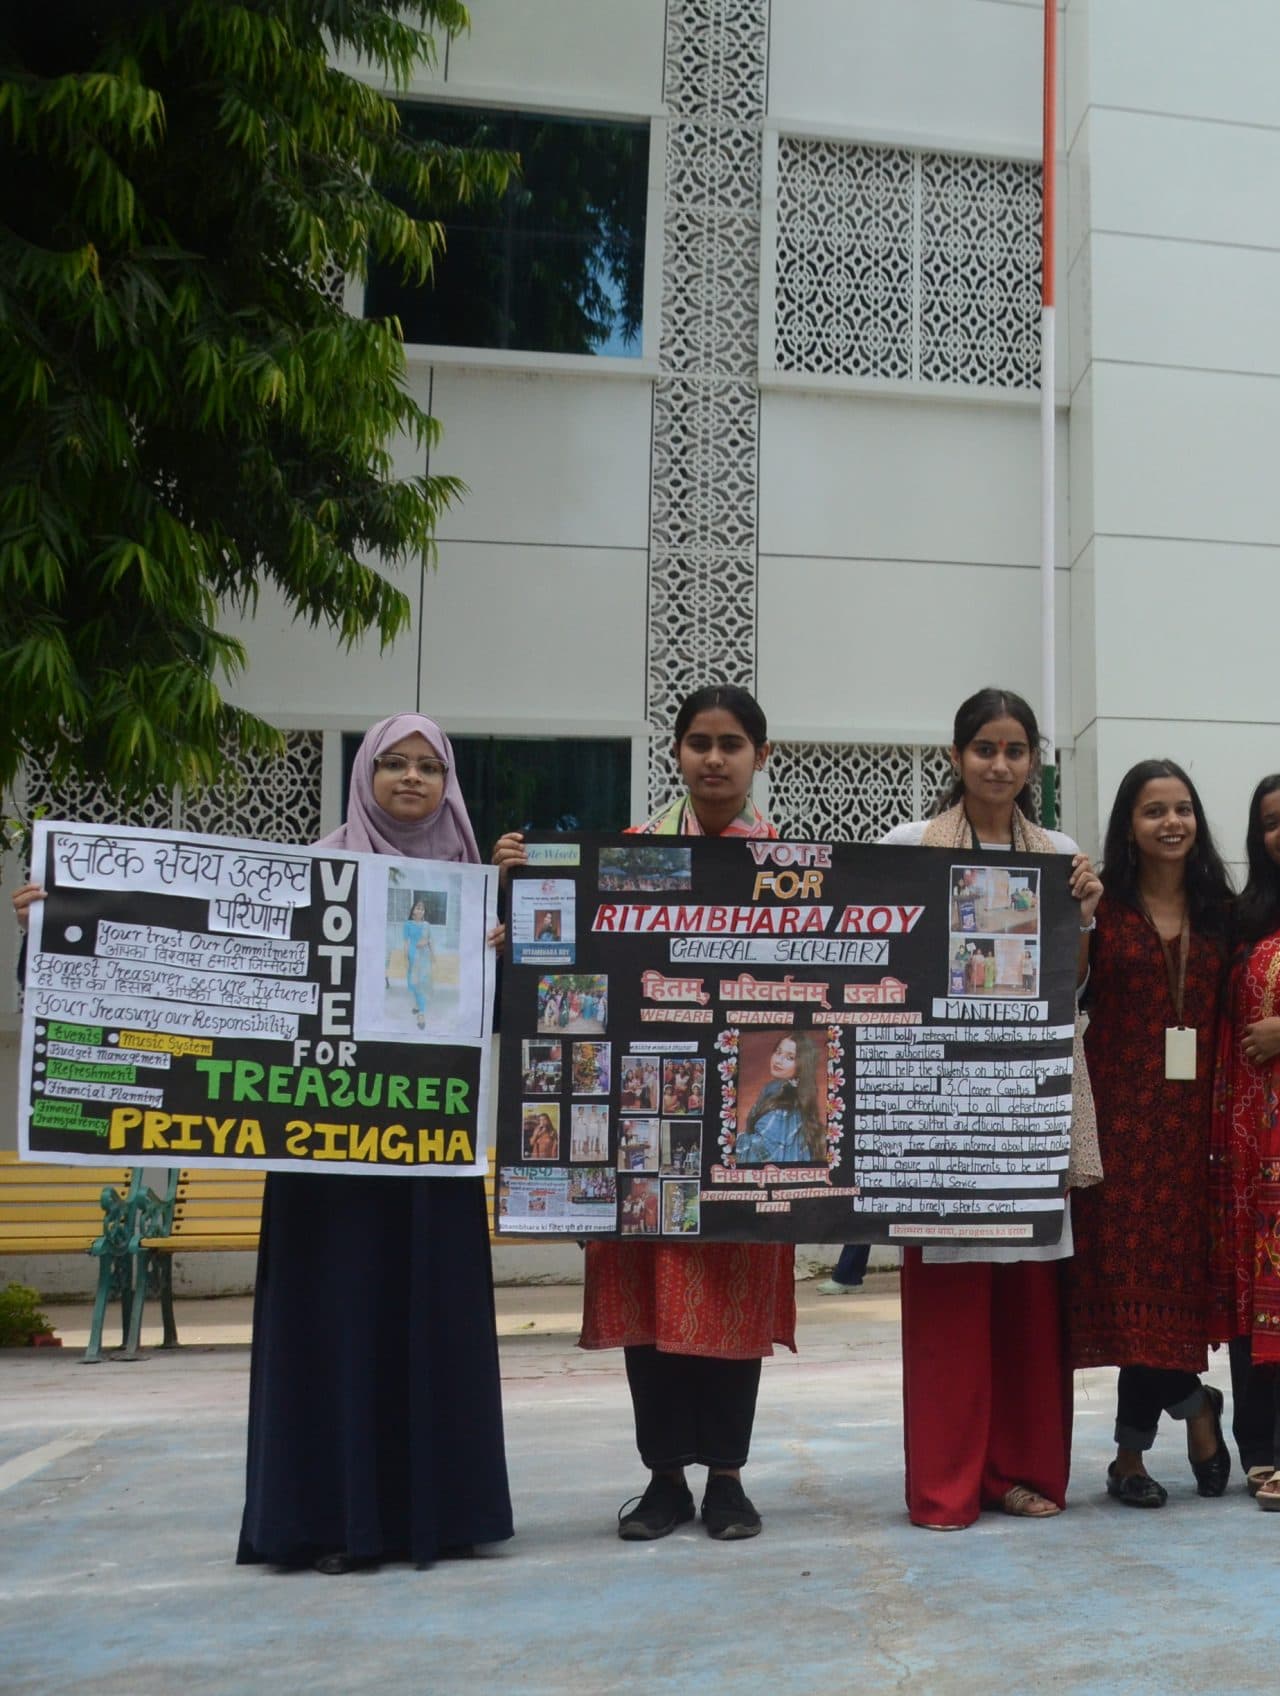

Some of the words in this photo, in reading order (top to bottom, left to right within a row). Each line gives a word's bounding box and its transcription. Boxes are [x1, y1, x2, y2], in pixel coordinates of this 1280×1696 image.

[746, 842, 832, 868] VOTE
[752, 871, 823, 900] FOR
[594, 905, 826, 933] RITAMBHARA
[840, 905, 923, 933] ROY
[147, 926, 183, 948] trust
[189, 934, 220, 952] Our
[223, 937, 306, 961] Commitment
[317, 861, 357, 1036] VOTE
[672, 938, 757, 962] GENERAL
[774, 940, 888, 963] SECRETARY
[32, 953, 100, 978] Honest
[36, 991, 88, 1016] Your
[89, 997, 162, 1030] Treasury
[164, 1011, 192, 1026] our
[193, 1009, 296, 1040] Responsibility
[640, 1009, 713, 1023] WELFARE
[727, 1011, 794, 1025] CHANGE
[812, 1012, 920, 1025] DEVELOPMENT
[945, 1001, 1039, 1021] MANIFESTO
[55, 1026, 102, 1044] Events
[1028, 1026, 1038, 1040] to
[1041, 1026, 1057, 1040] the
[50, 1043, 92, 1060] Budget
[168, 1037, 212, 1056] System
[293, 1040, 358, 1067] FOR
[859, 1044, 889, 1060] higher
[50, 1060, 134, 1081] Refreshment
[975, 1065, 987, 1076] on
[196, 1059, 471, 1115] TREASURER
[110, 1088, 164, 1108] Planning
[968, 1095, 979, 1112] to
[985, 1096, 1000, 1113] all
[109, 1108, 266, 1155] PRIYA
[285, 1120, 474, 1163] SINGHA
[928, 1156, 941, 1171] all
[1007, 1157, 1017, 1172] to
[700, 1190, 769, 1202] Dedication
[895, 1197, 913, 1213] and
[755, 1201, 792, 1213] Truth
